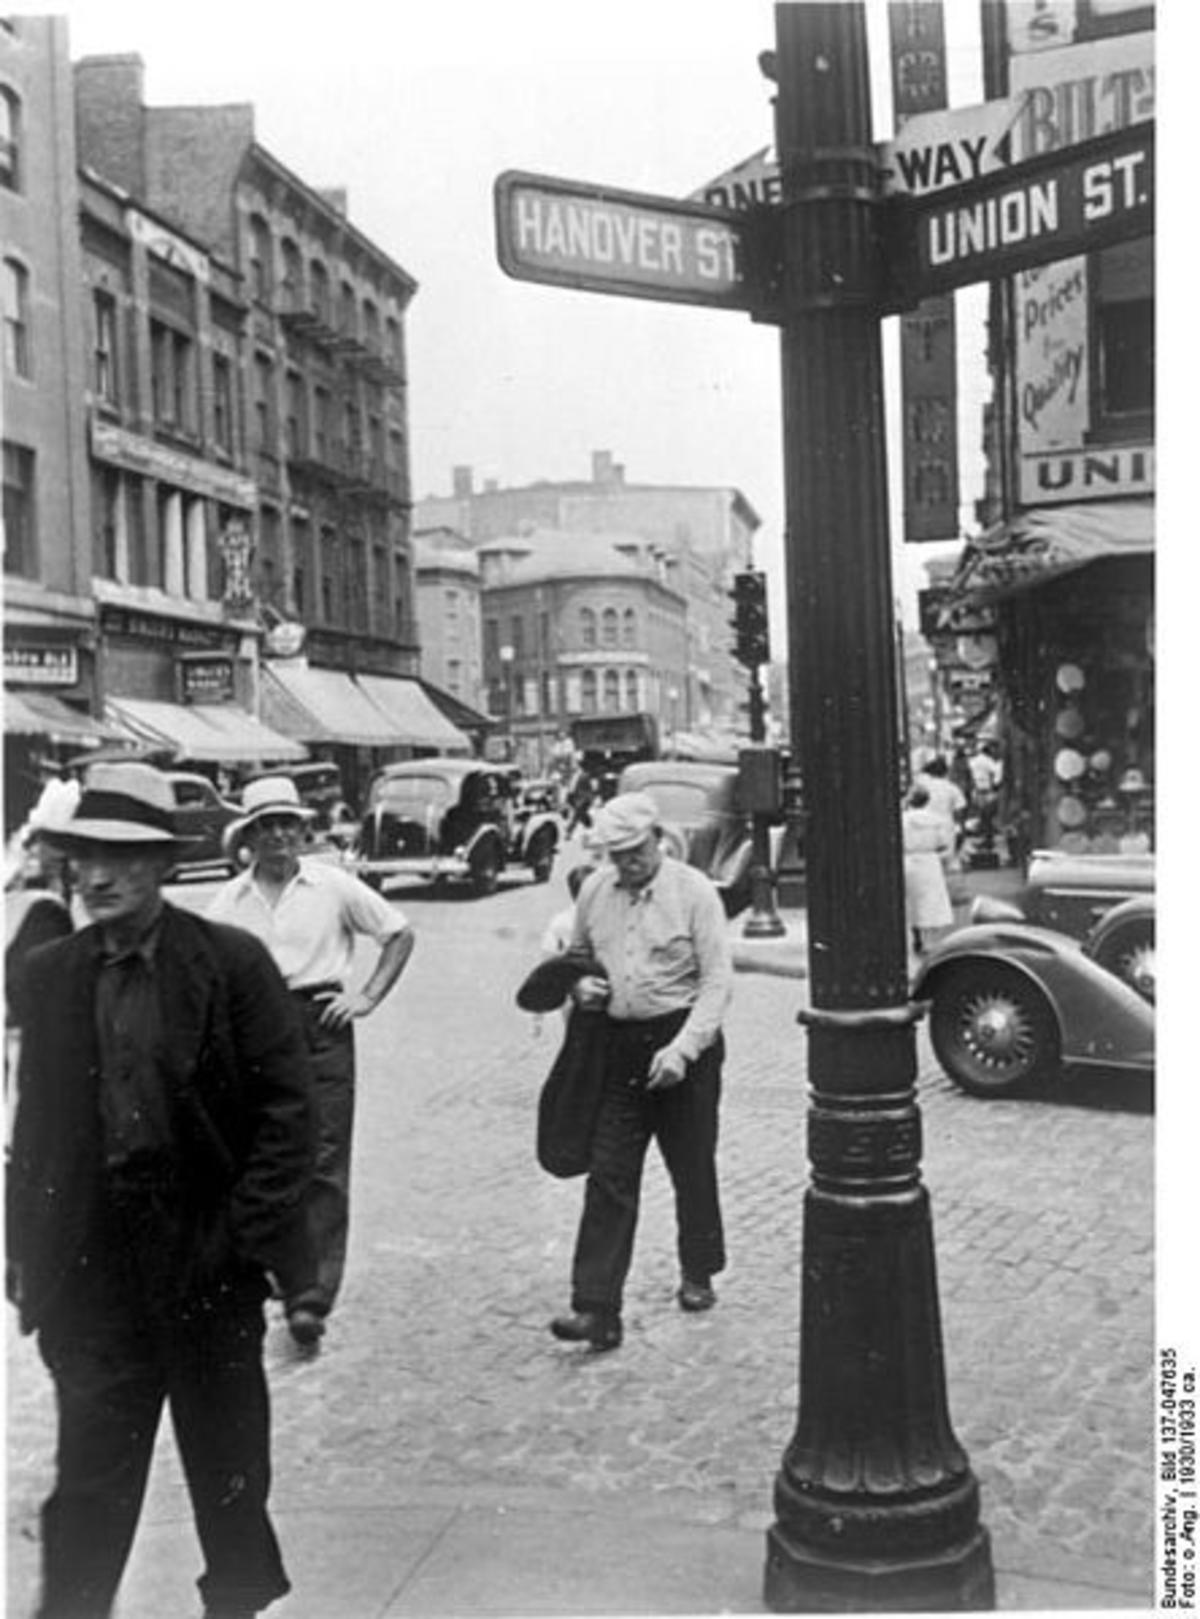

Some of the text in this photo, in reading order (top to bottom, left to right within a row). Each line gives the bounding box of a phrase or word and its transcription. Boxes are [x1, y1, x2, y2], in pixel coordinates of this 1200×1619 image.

[896, 135, 988, 188] WAY
[517, 197, 744, 282] HANOVER ST.
[929, 150, 1148, 266] UNION ST.
[1037, 452, 1146, 491] UNI
